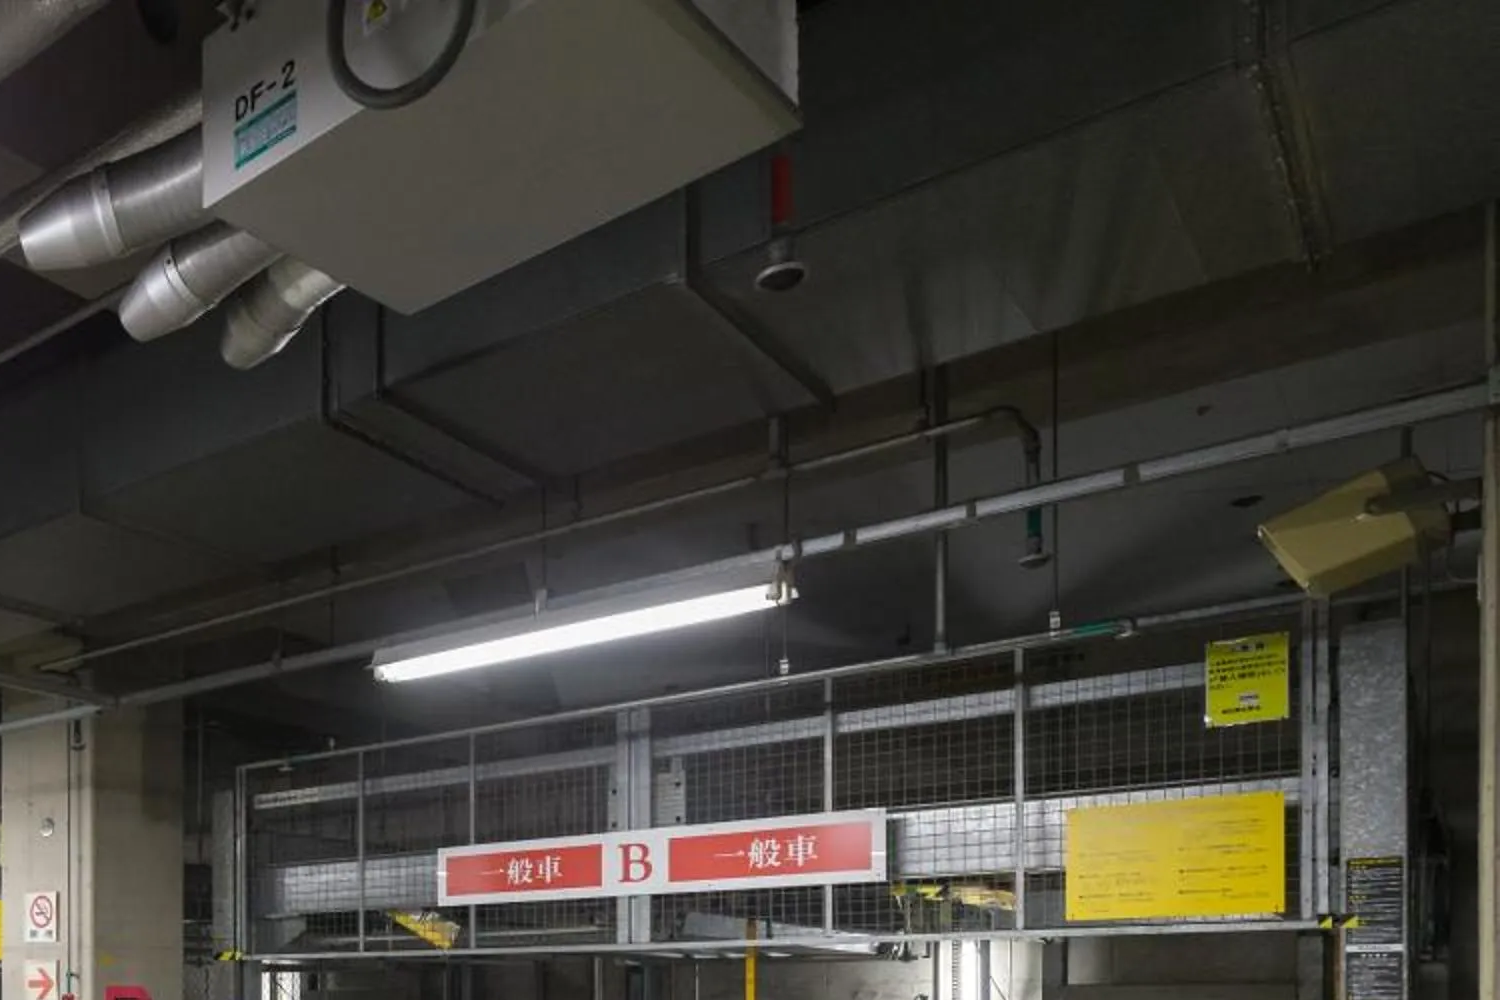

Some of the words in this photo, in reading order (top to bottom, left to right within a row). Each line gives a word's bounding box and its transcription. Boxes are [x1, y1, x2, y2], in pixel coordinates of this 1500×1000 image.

[235, 59, 296, 121] DF-2
[481, 855, 563, 885] 一般車
[617, 843, 653, 882] B
[715, 835, 819, 869] 一般車
